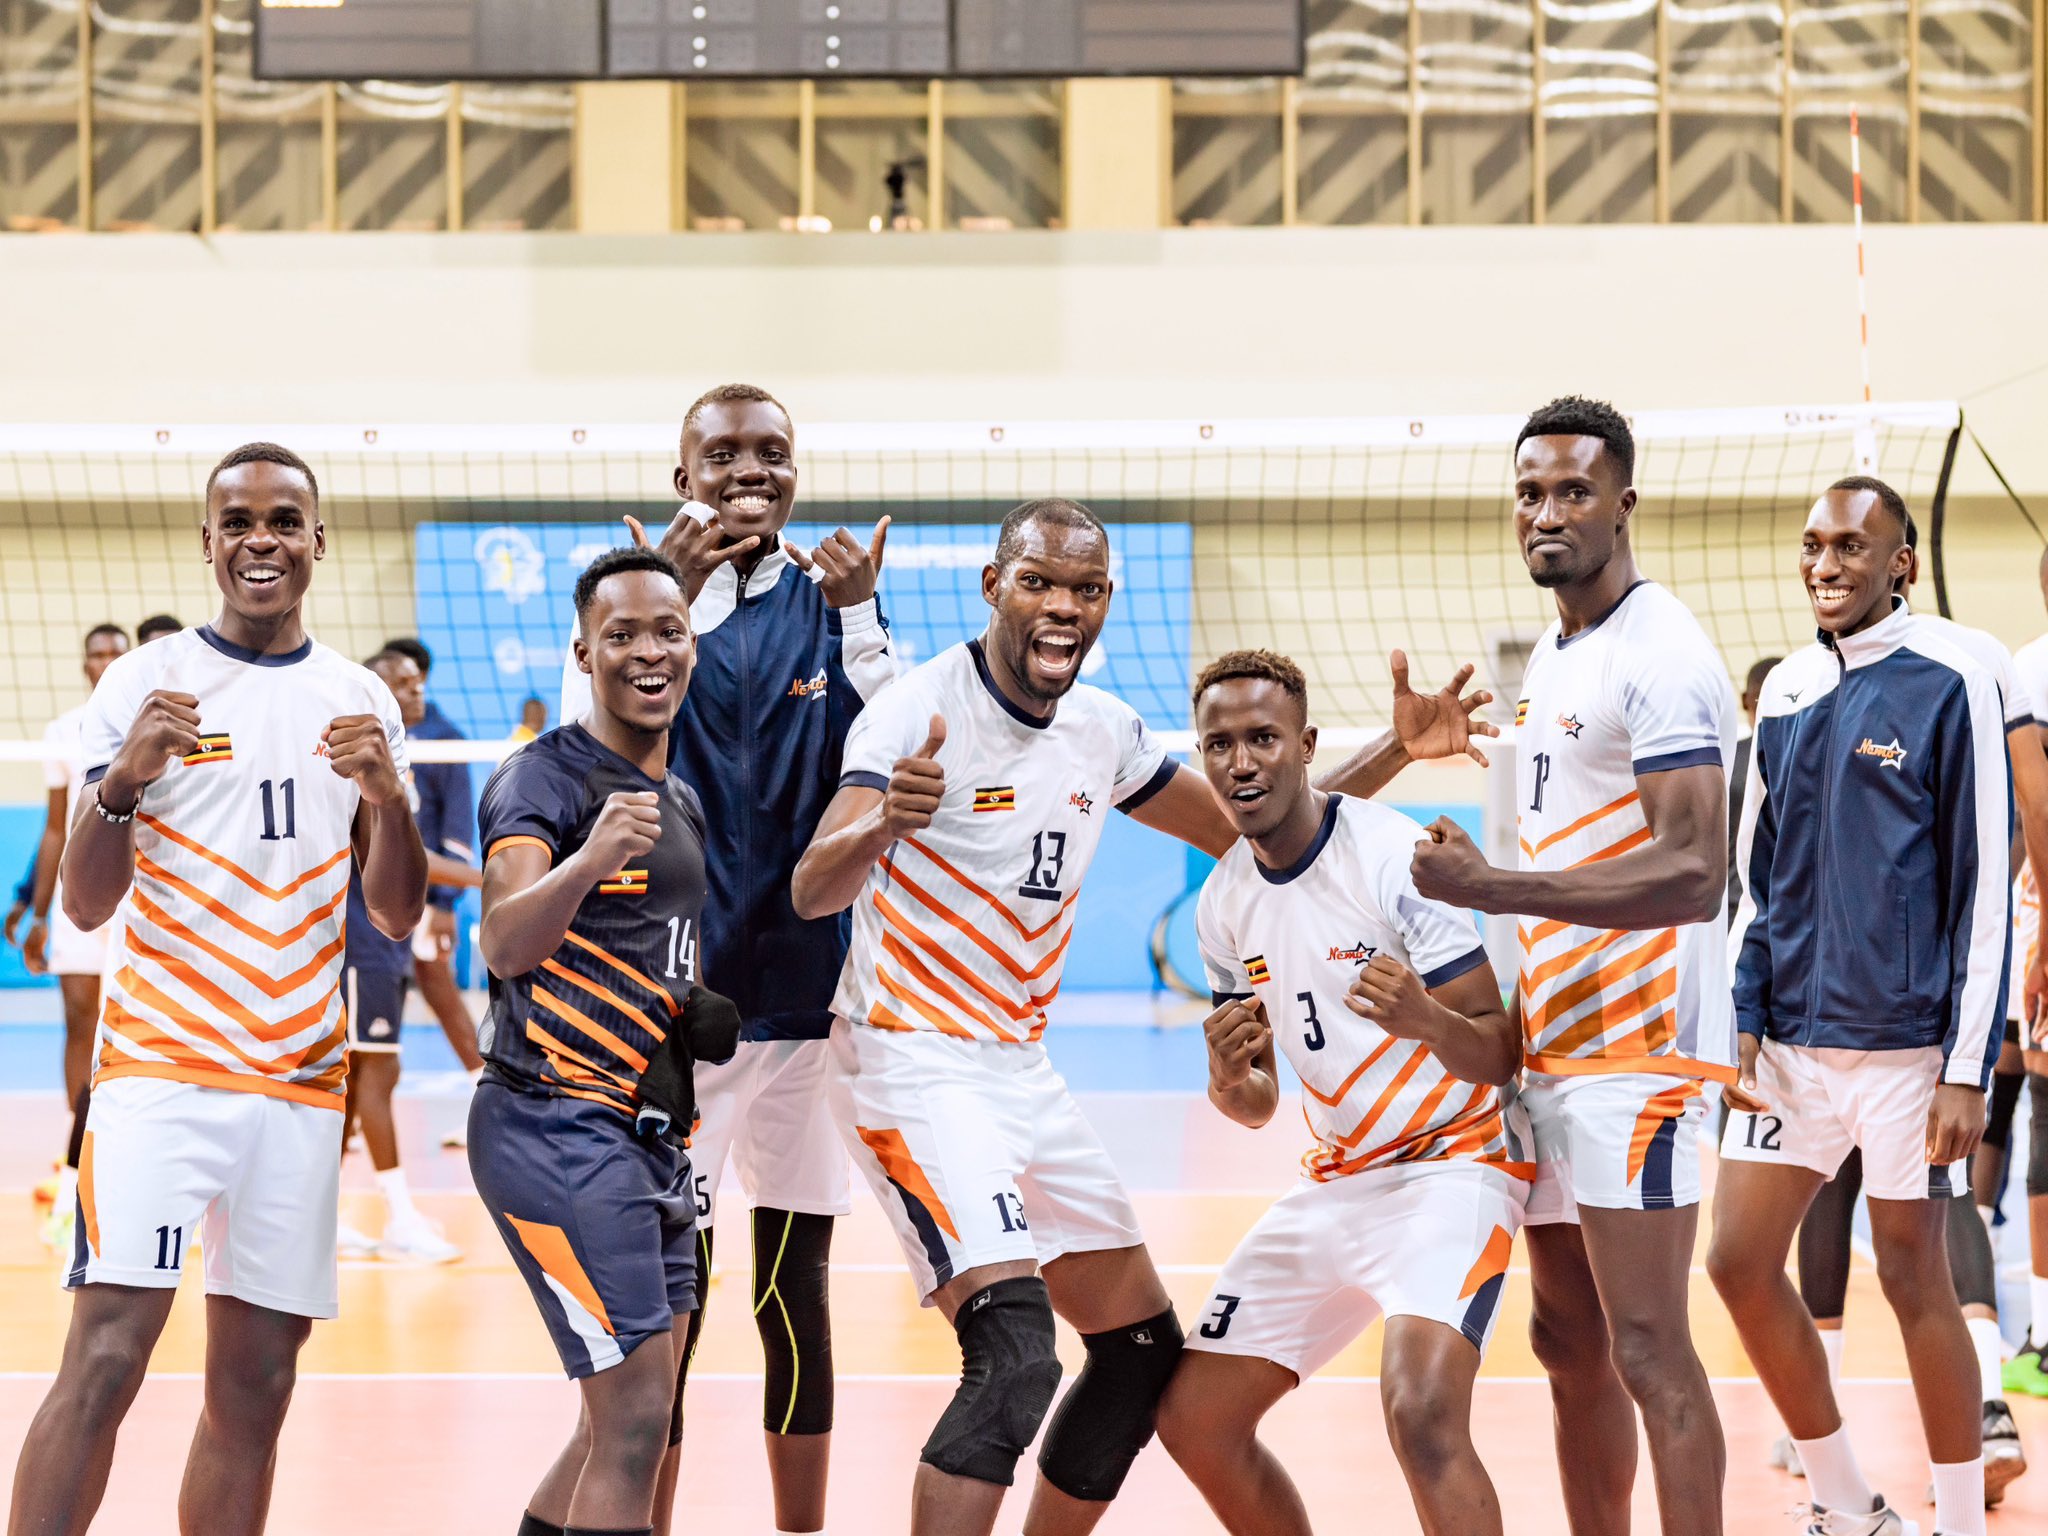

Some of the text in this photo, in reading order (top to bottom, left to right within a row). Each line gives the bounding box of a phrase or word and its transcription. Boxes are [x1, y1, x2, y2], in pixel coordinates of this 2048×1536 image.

[1855, 738, 1900, 759] Nemo
[259, 778, 296, 840] 11
[1024, 831, 1066, 889] 13
[665, 915, 696, 981] 14
[1326, 946, 1366, 961] Nemo
[1296, 991, 1326, 1051] 3
[1743, 1114, 1783, 1151] 12
[694, 1174, 711, 1217] 5
[992, 1192, 1028, 1232] 13
[154, 1225, 182, 1270] 11
[1200, 1294, 1241, 1339] 3
